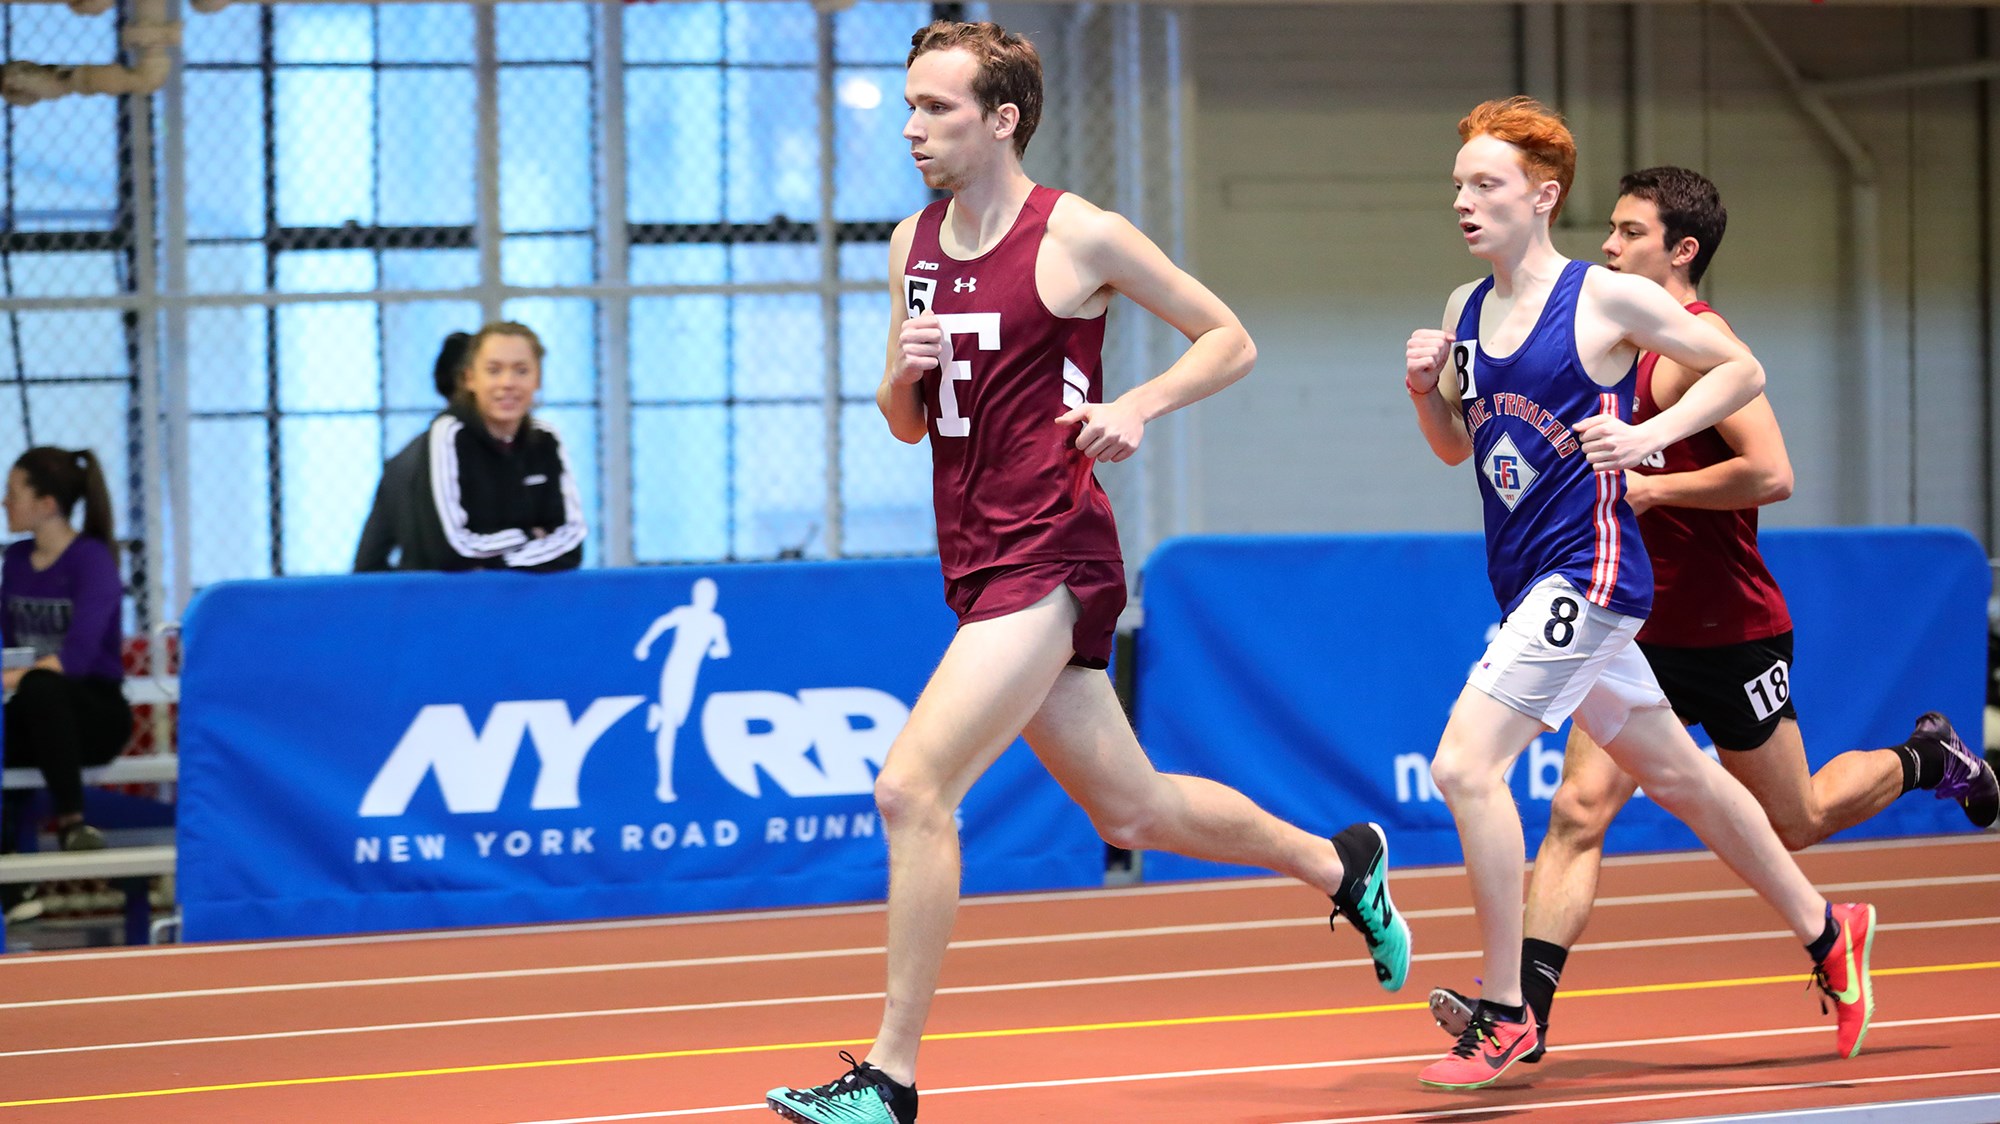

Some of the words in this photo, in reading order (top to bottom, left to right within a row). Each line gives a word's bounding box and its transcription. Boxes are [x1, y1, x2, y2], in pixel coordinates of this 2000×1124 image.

[909, 279, 928, 319] 5
[934, 313, 1001, 438] F
[1493, 392, 1580, 459] FRANCAIS
[1543, 596, 1579, 648] 8
[1750, 666, 1788, 714] 18
[354, 835, 446, 865] NEW
[474, 827, 596, 858] YORK
[621, 818, 740, 852] ROAD
